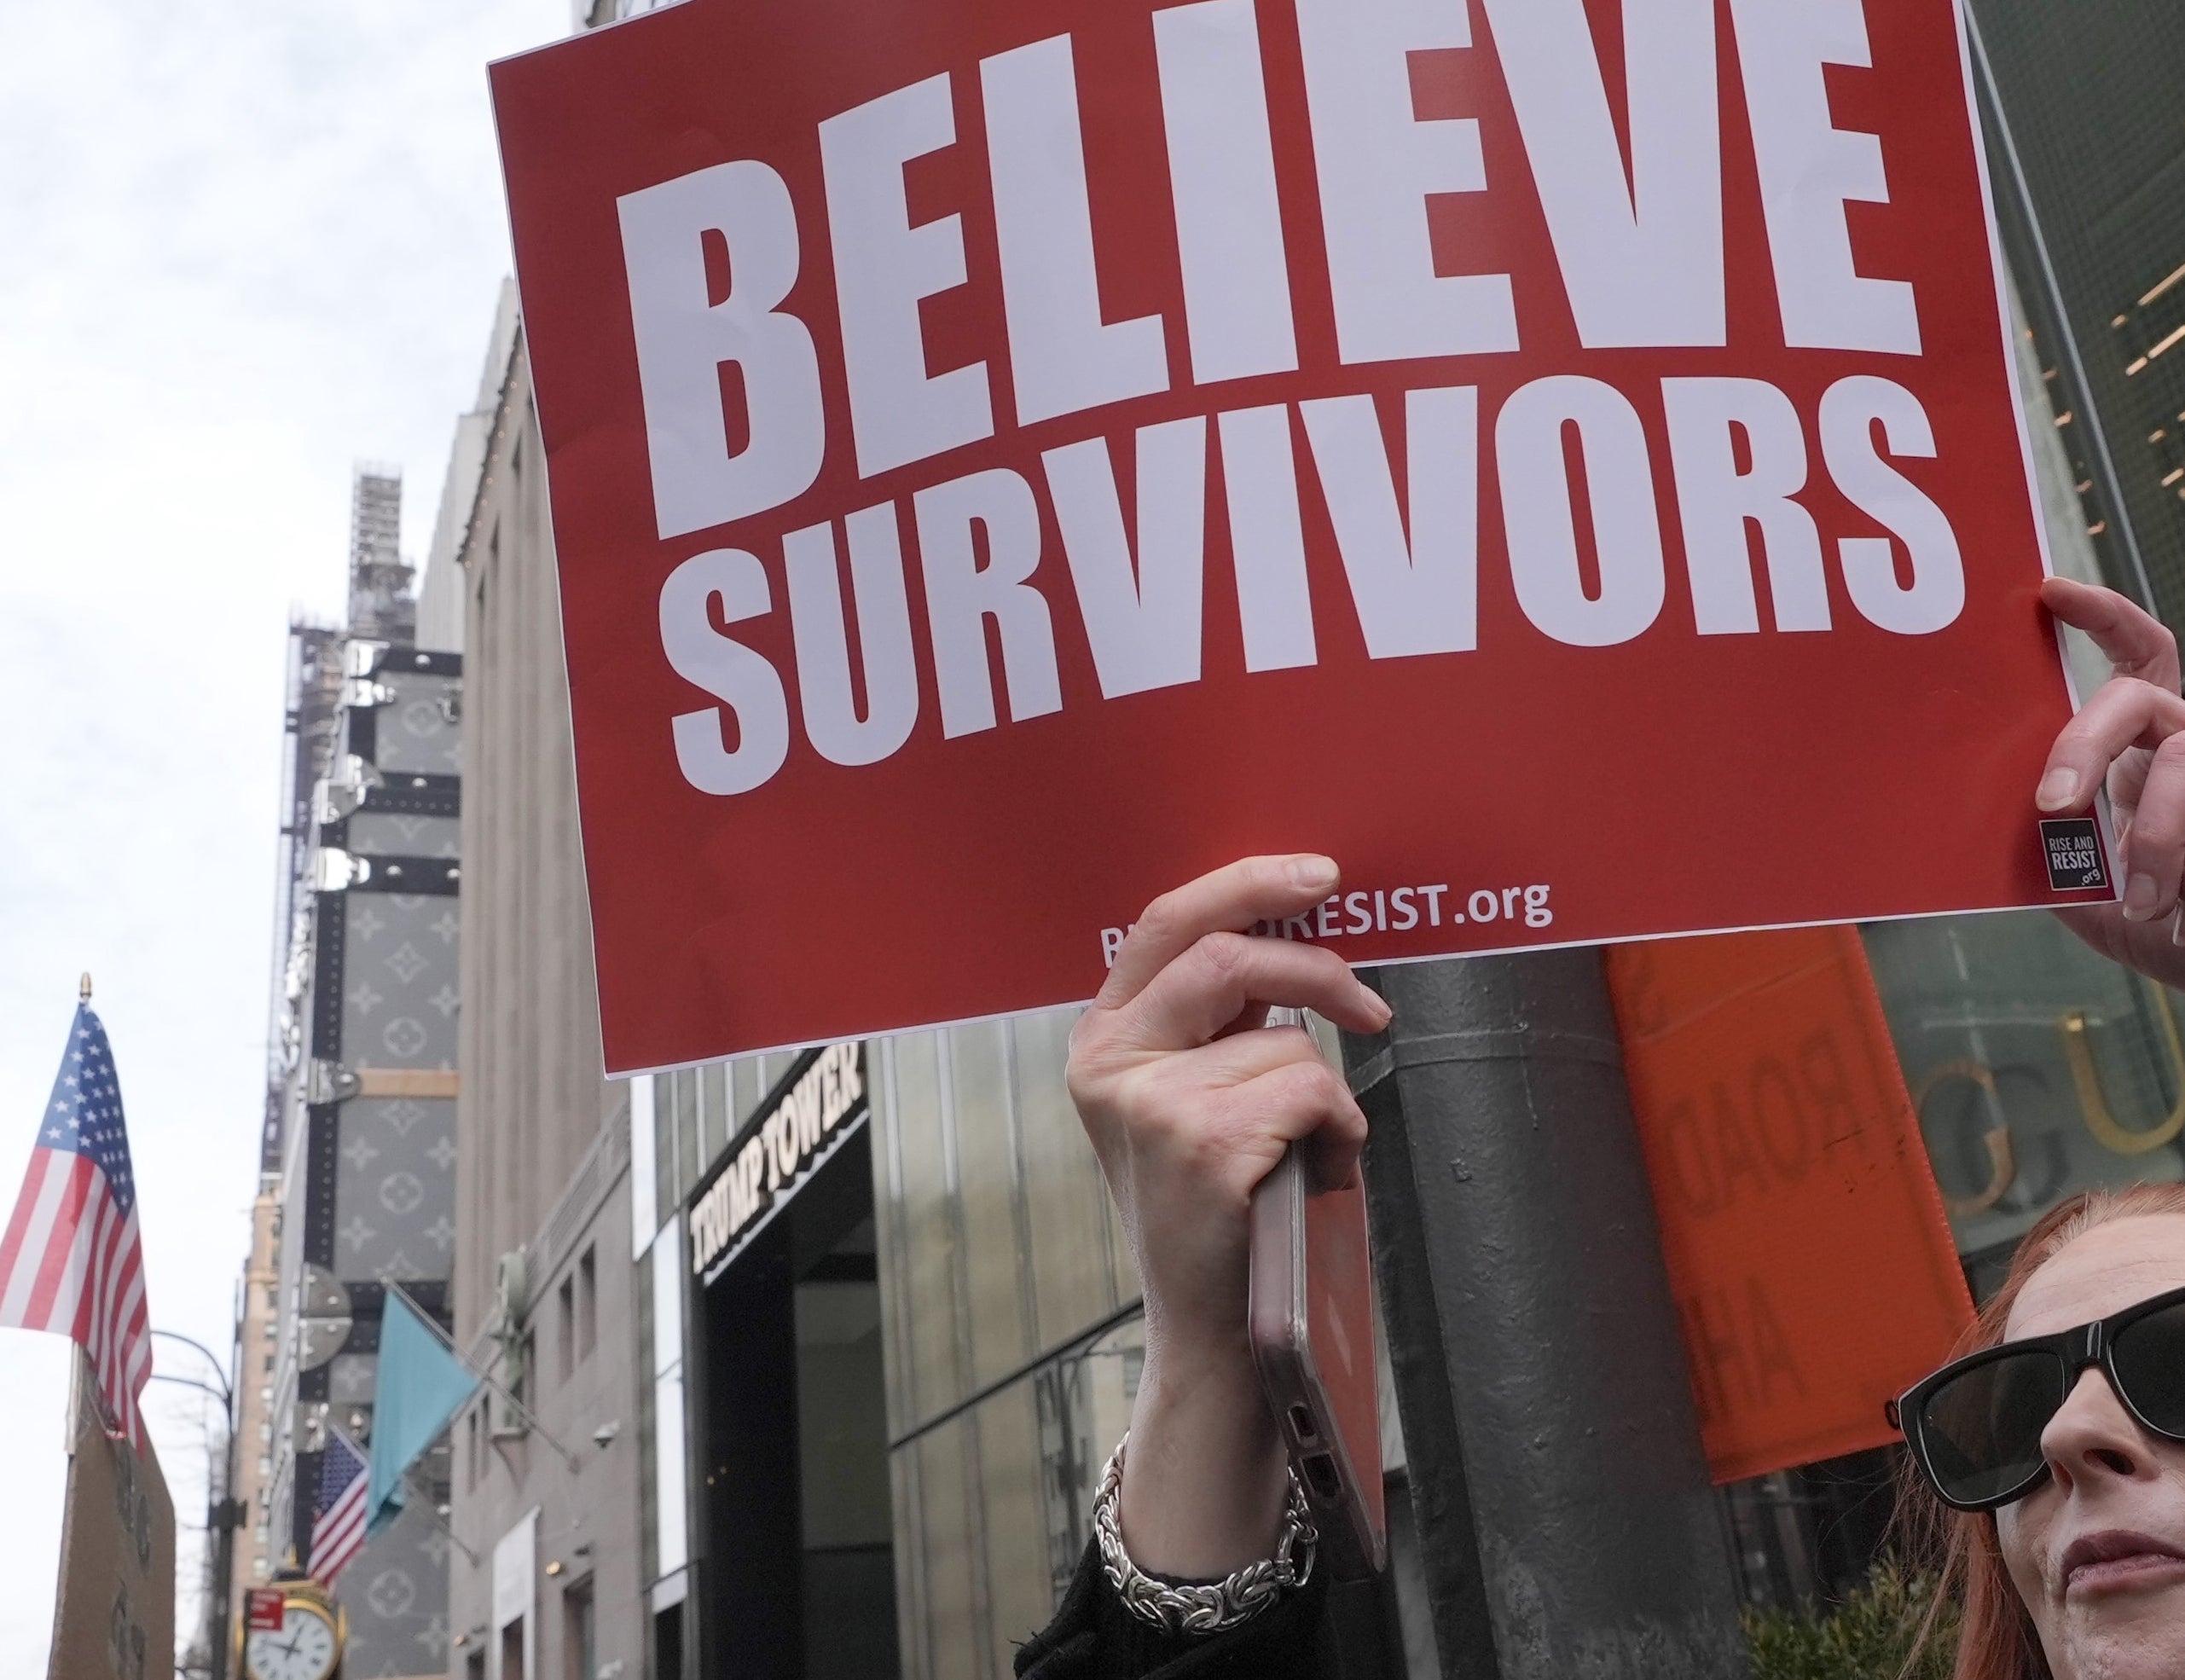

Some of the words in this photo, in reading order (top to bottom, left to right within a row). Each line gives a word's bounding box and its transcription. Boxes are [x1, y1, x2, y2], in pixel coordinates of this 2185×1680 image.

[617, 0, 1921, 541] BELIEVE
[659, 375, 1965, 795] SURVIVORS
[2049, 837, 2072, 851] RISE
[2074, 837, 2095, 850] AND
[2051, 851, 2096, 870] RESIST
[2081, 868, 2101, 886] .org
[689, 1135, 763, 1275] TRUMP
[762, 1042, 862, 1192] TOWER
